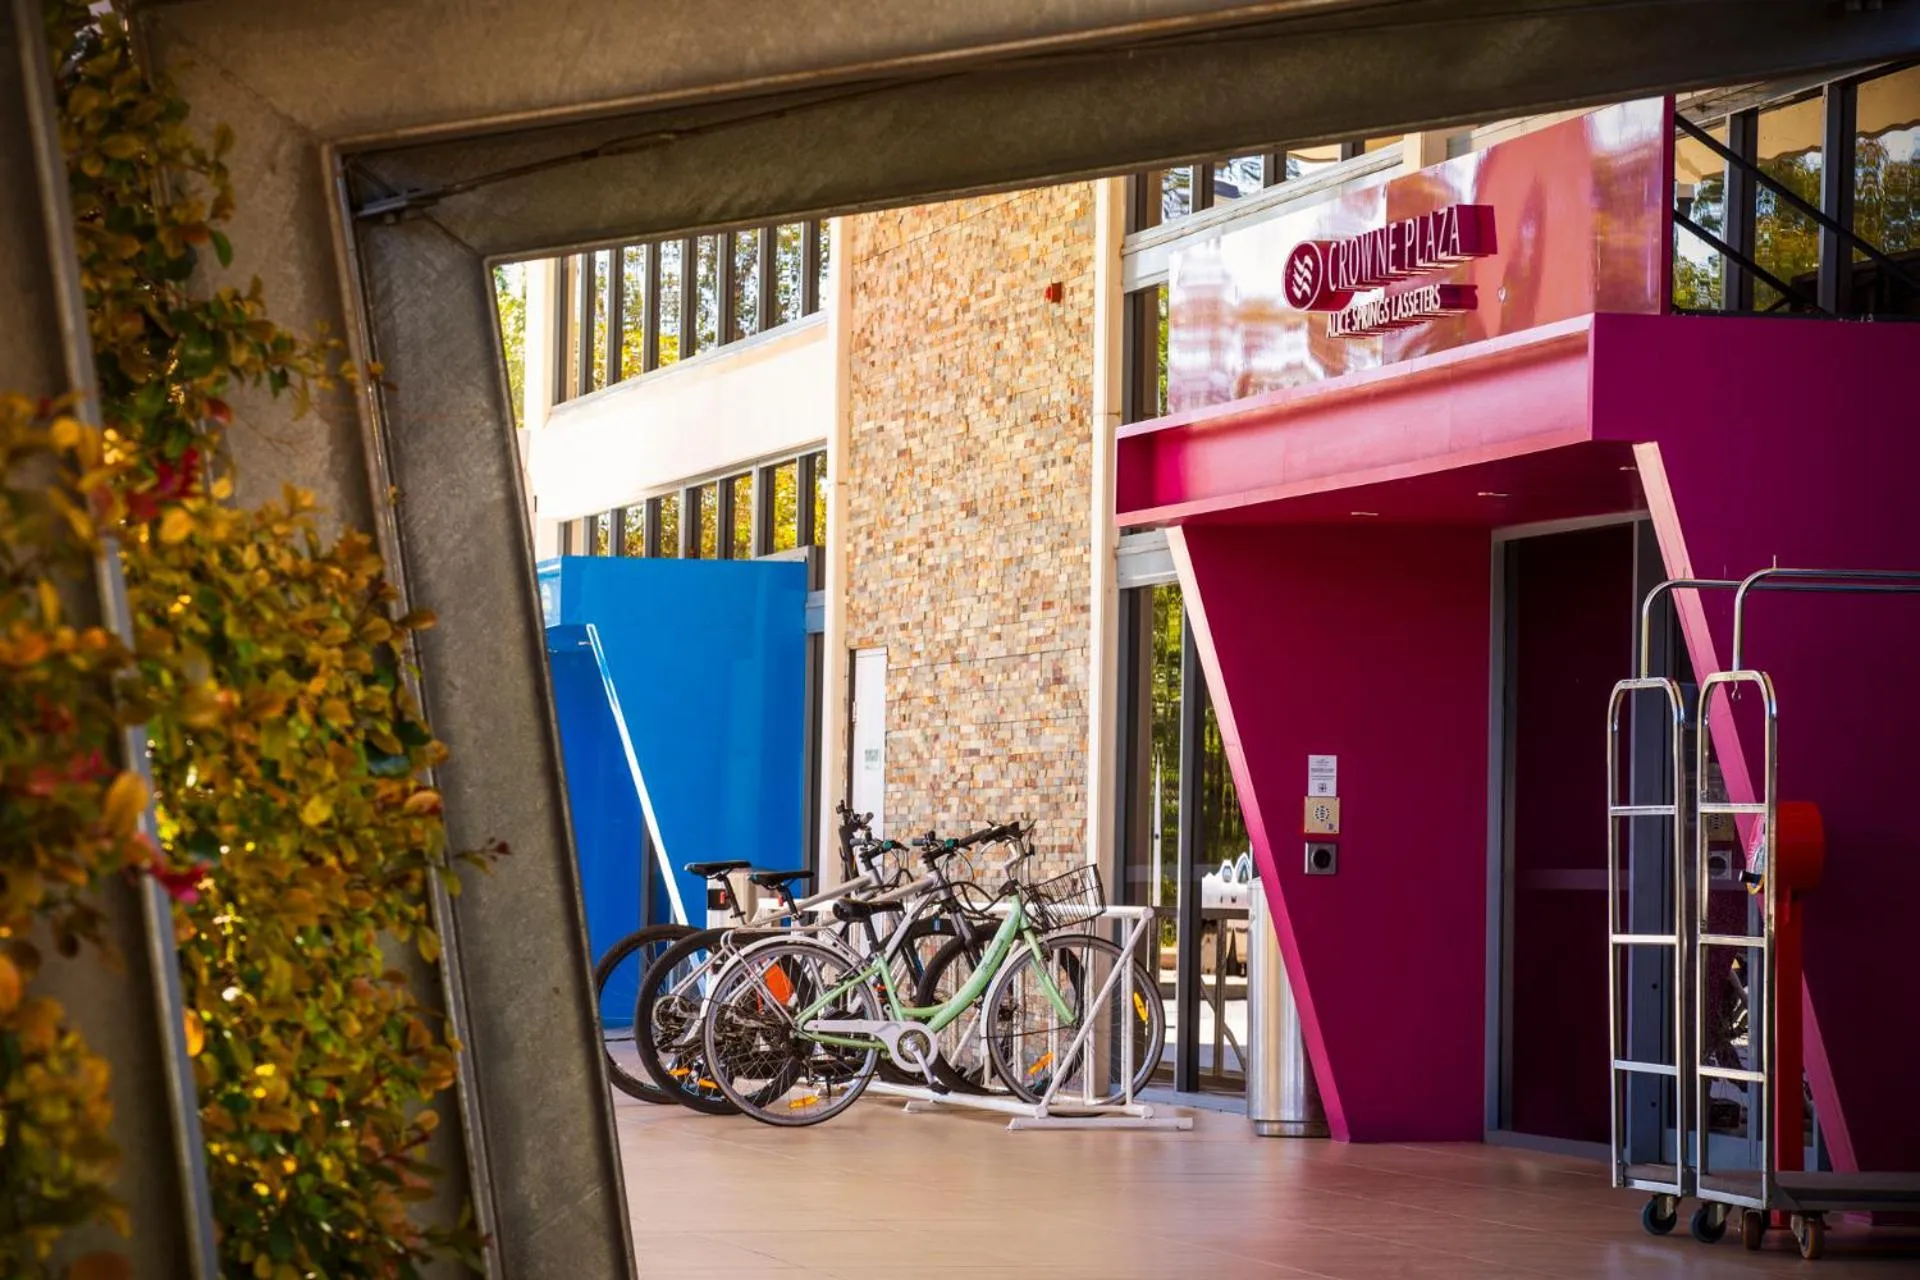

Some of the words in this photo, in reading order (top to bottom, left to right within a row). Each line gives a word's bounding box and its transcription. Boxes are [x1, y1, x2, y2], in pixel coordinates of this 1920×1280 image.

[1328, 222, 1397, 292] CROWNE
[1404, 207, 1461, 270] PLAZA
[1326, 309, 1351, 338] ALICE
[1352, 297, 1390, 330] SPRINGS
[1391, 283, 1441, 321] LASSETERS
